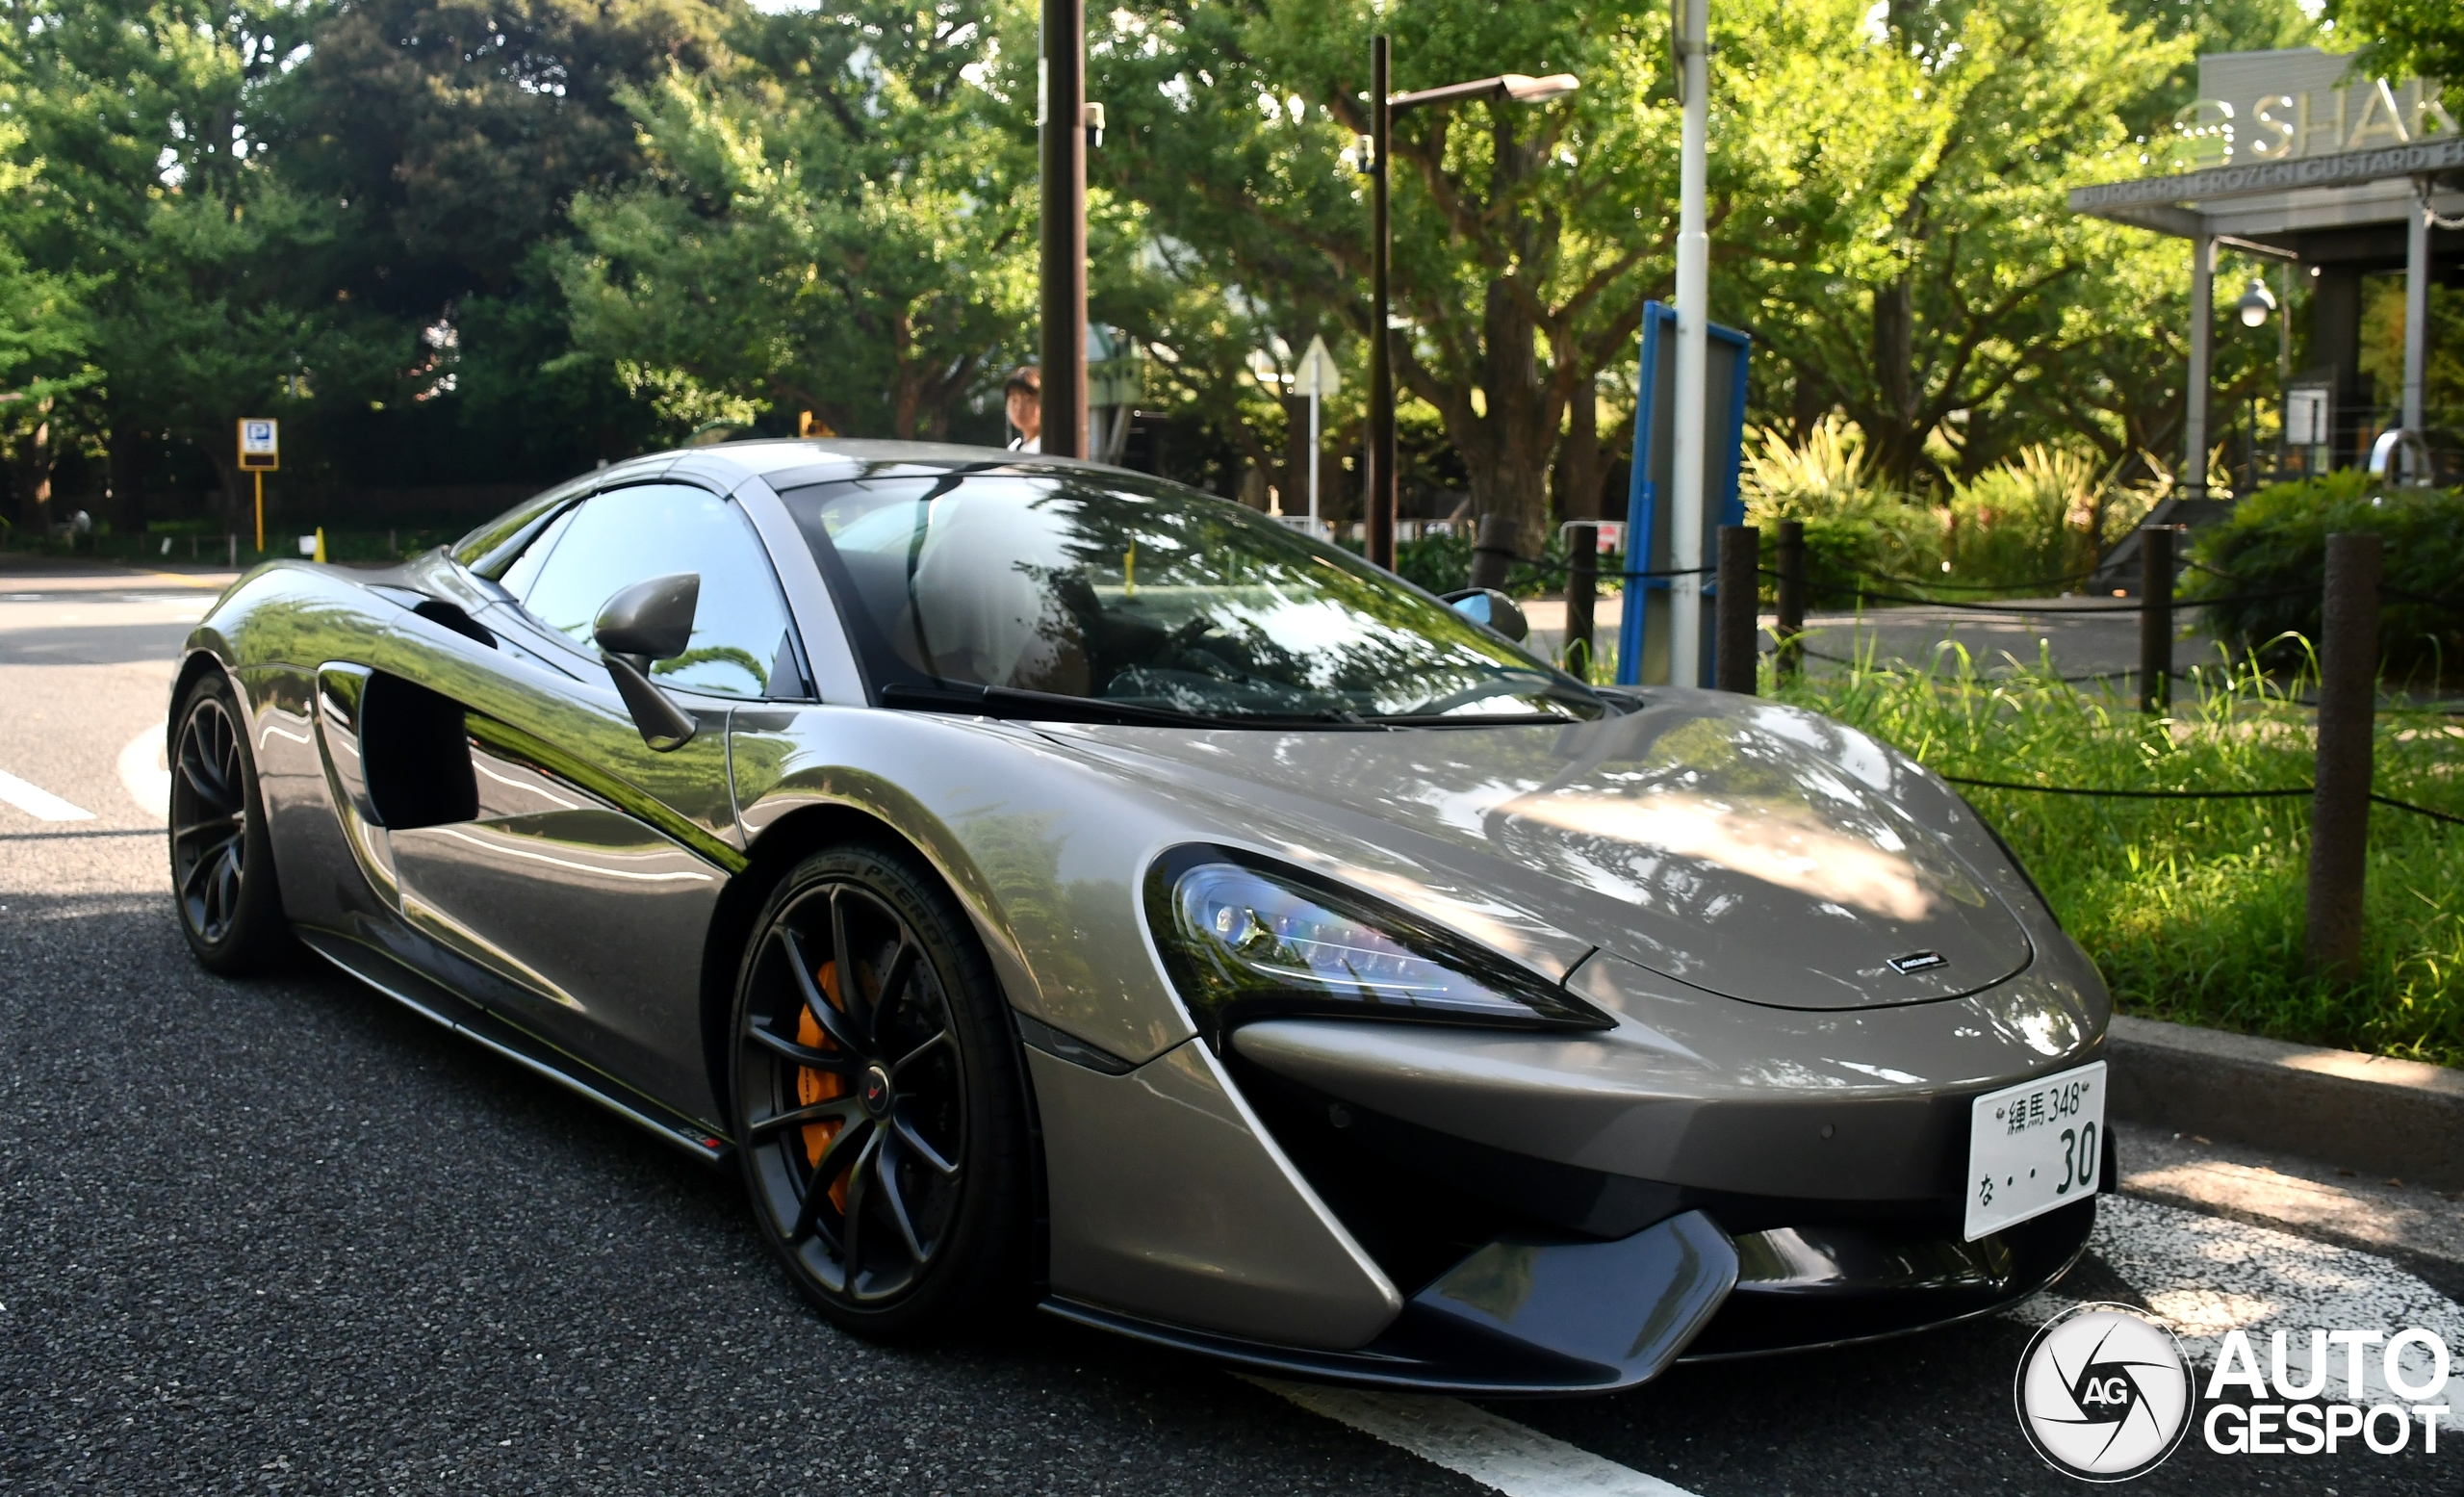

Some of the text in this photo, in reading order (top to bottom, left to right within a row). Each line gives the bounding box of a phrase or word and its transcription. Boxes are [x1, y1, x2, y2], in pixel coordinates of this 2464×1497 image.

[2195, 163, 2297, 193] FROZEN
[2006, 1081, 2080, 1135] 練馬 348
[1979, 1174, 1994, 1207] な
[2056, 1121, 2096, 1195] 30
